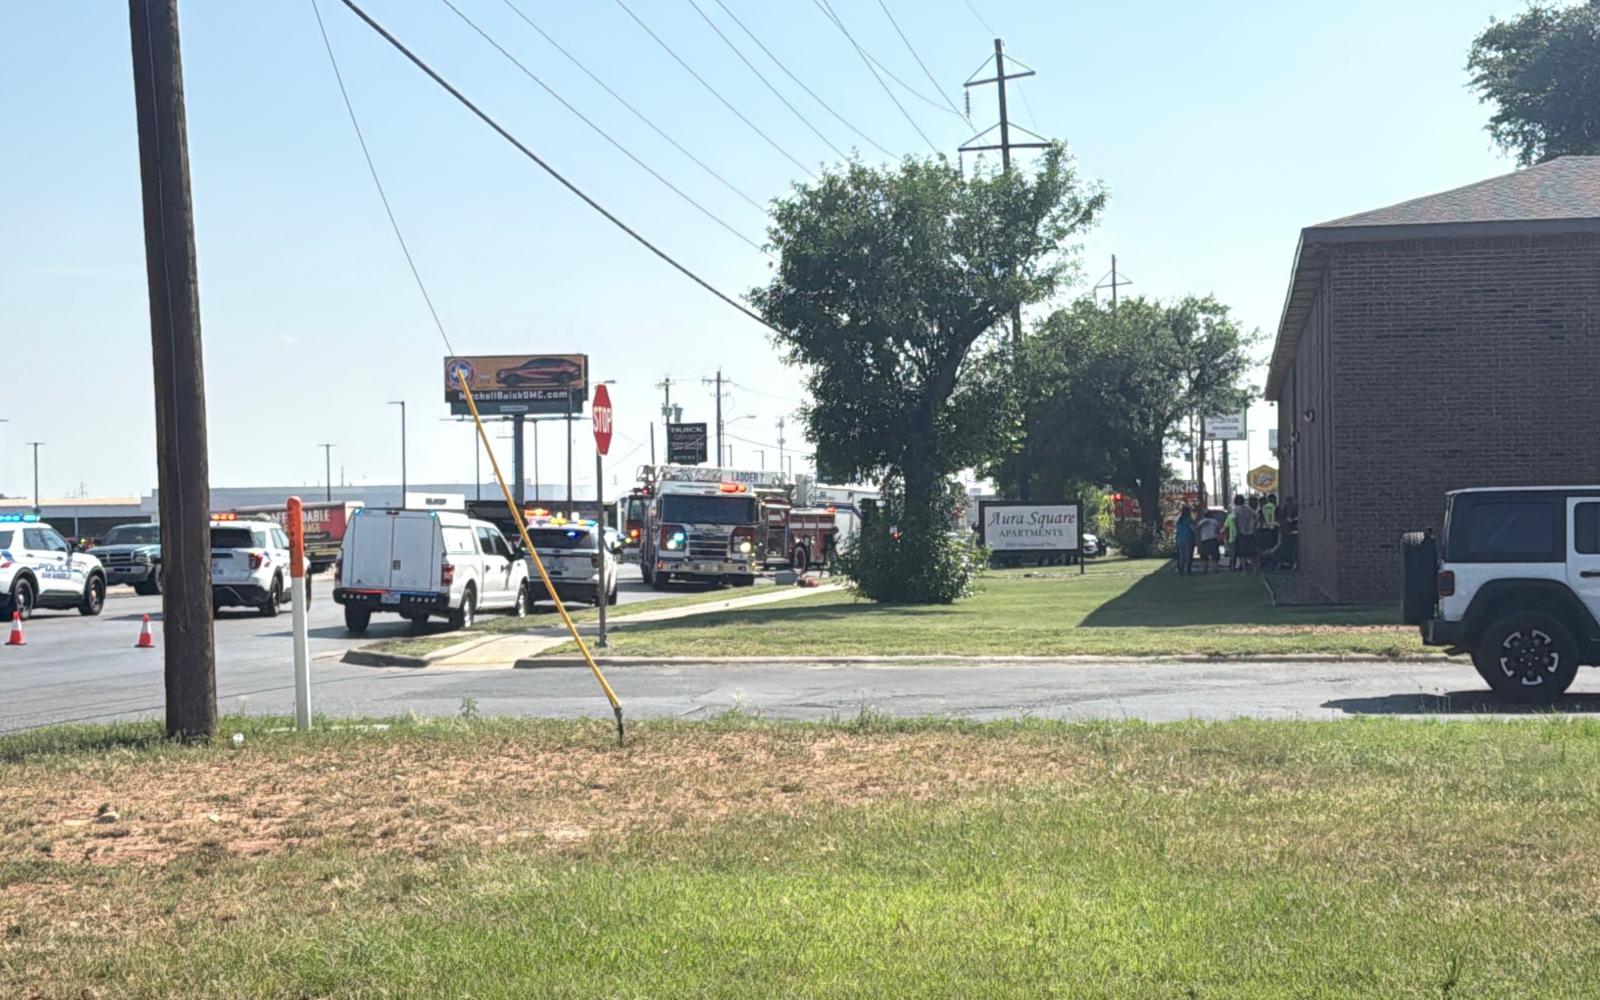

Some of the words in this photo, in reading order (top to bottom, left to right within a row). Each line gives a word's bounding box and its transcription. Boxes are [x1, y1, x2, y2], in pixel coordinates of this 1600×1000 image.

[458, 390, 568, 401] MchellBuickGMC.com
[593, 405, 611, 433] STOP
[731, 471, 758, 483] LADDER
[271, 509, 331, 524] AFFDABLE
[987, 511, 1024, 527] Aura
[1027, 510, 1075, 528] Square
[1000, 527, 1064, 538] APARTMENTS
[38, 562, 73, 573] POLICE
